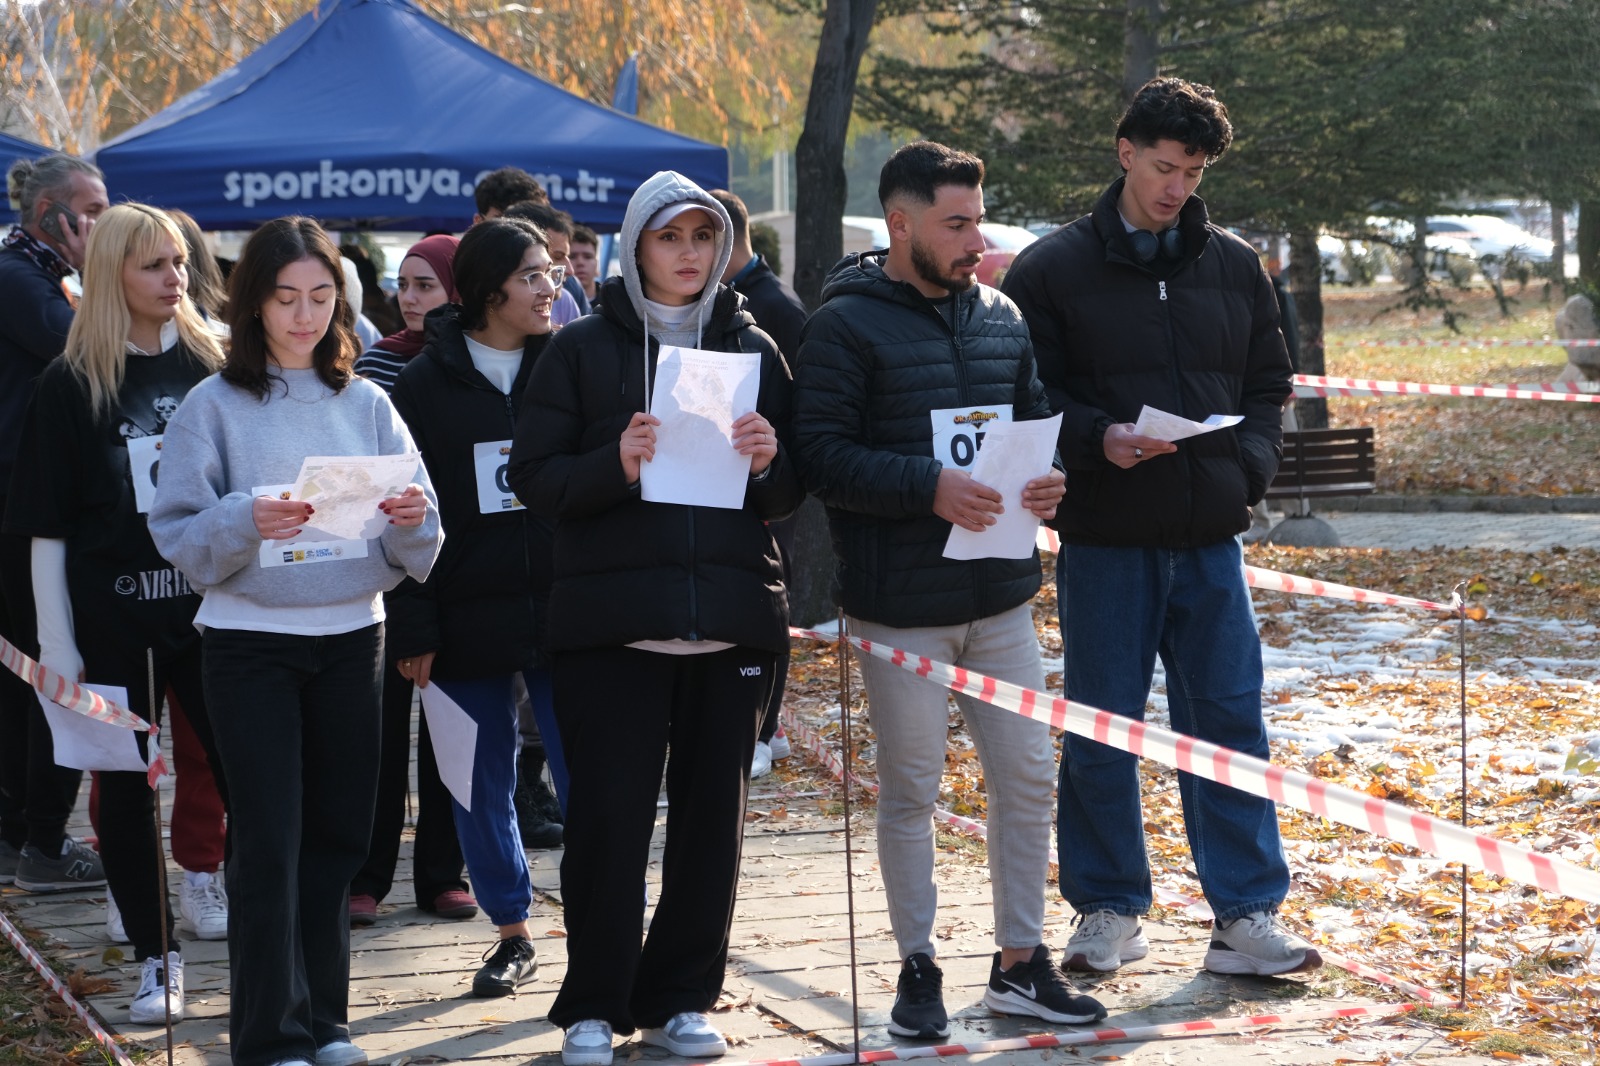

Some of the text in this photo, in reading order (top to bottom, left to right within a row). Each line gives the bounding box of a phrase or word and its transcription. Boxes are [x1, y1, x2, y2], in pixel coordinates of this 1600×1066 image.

[223, 160, 615, 207] sporkonya.m.tr
[137, 567, 192, 600] NIRVA
[740, 666, 761, 677] VOID
